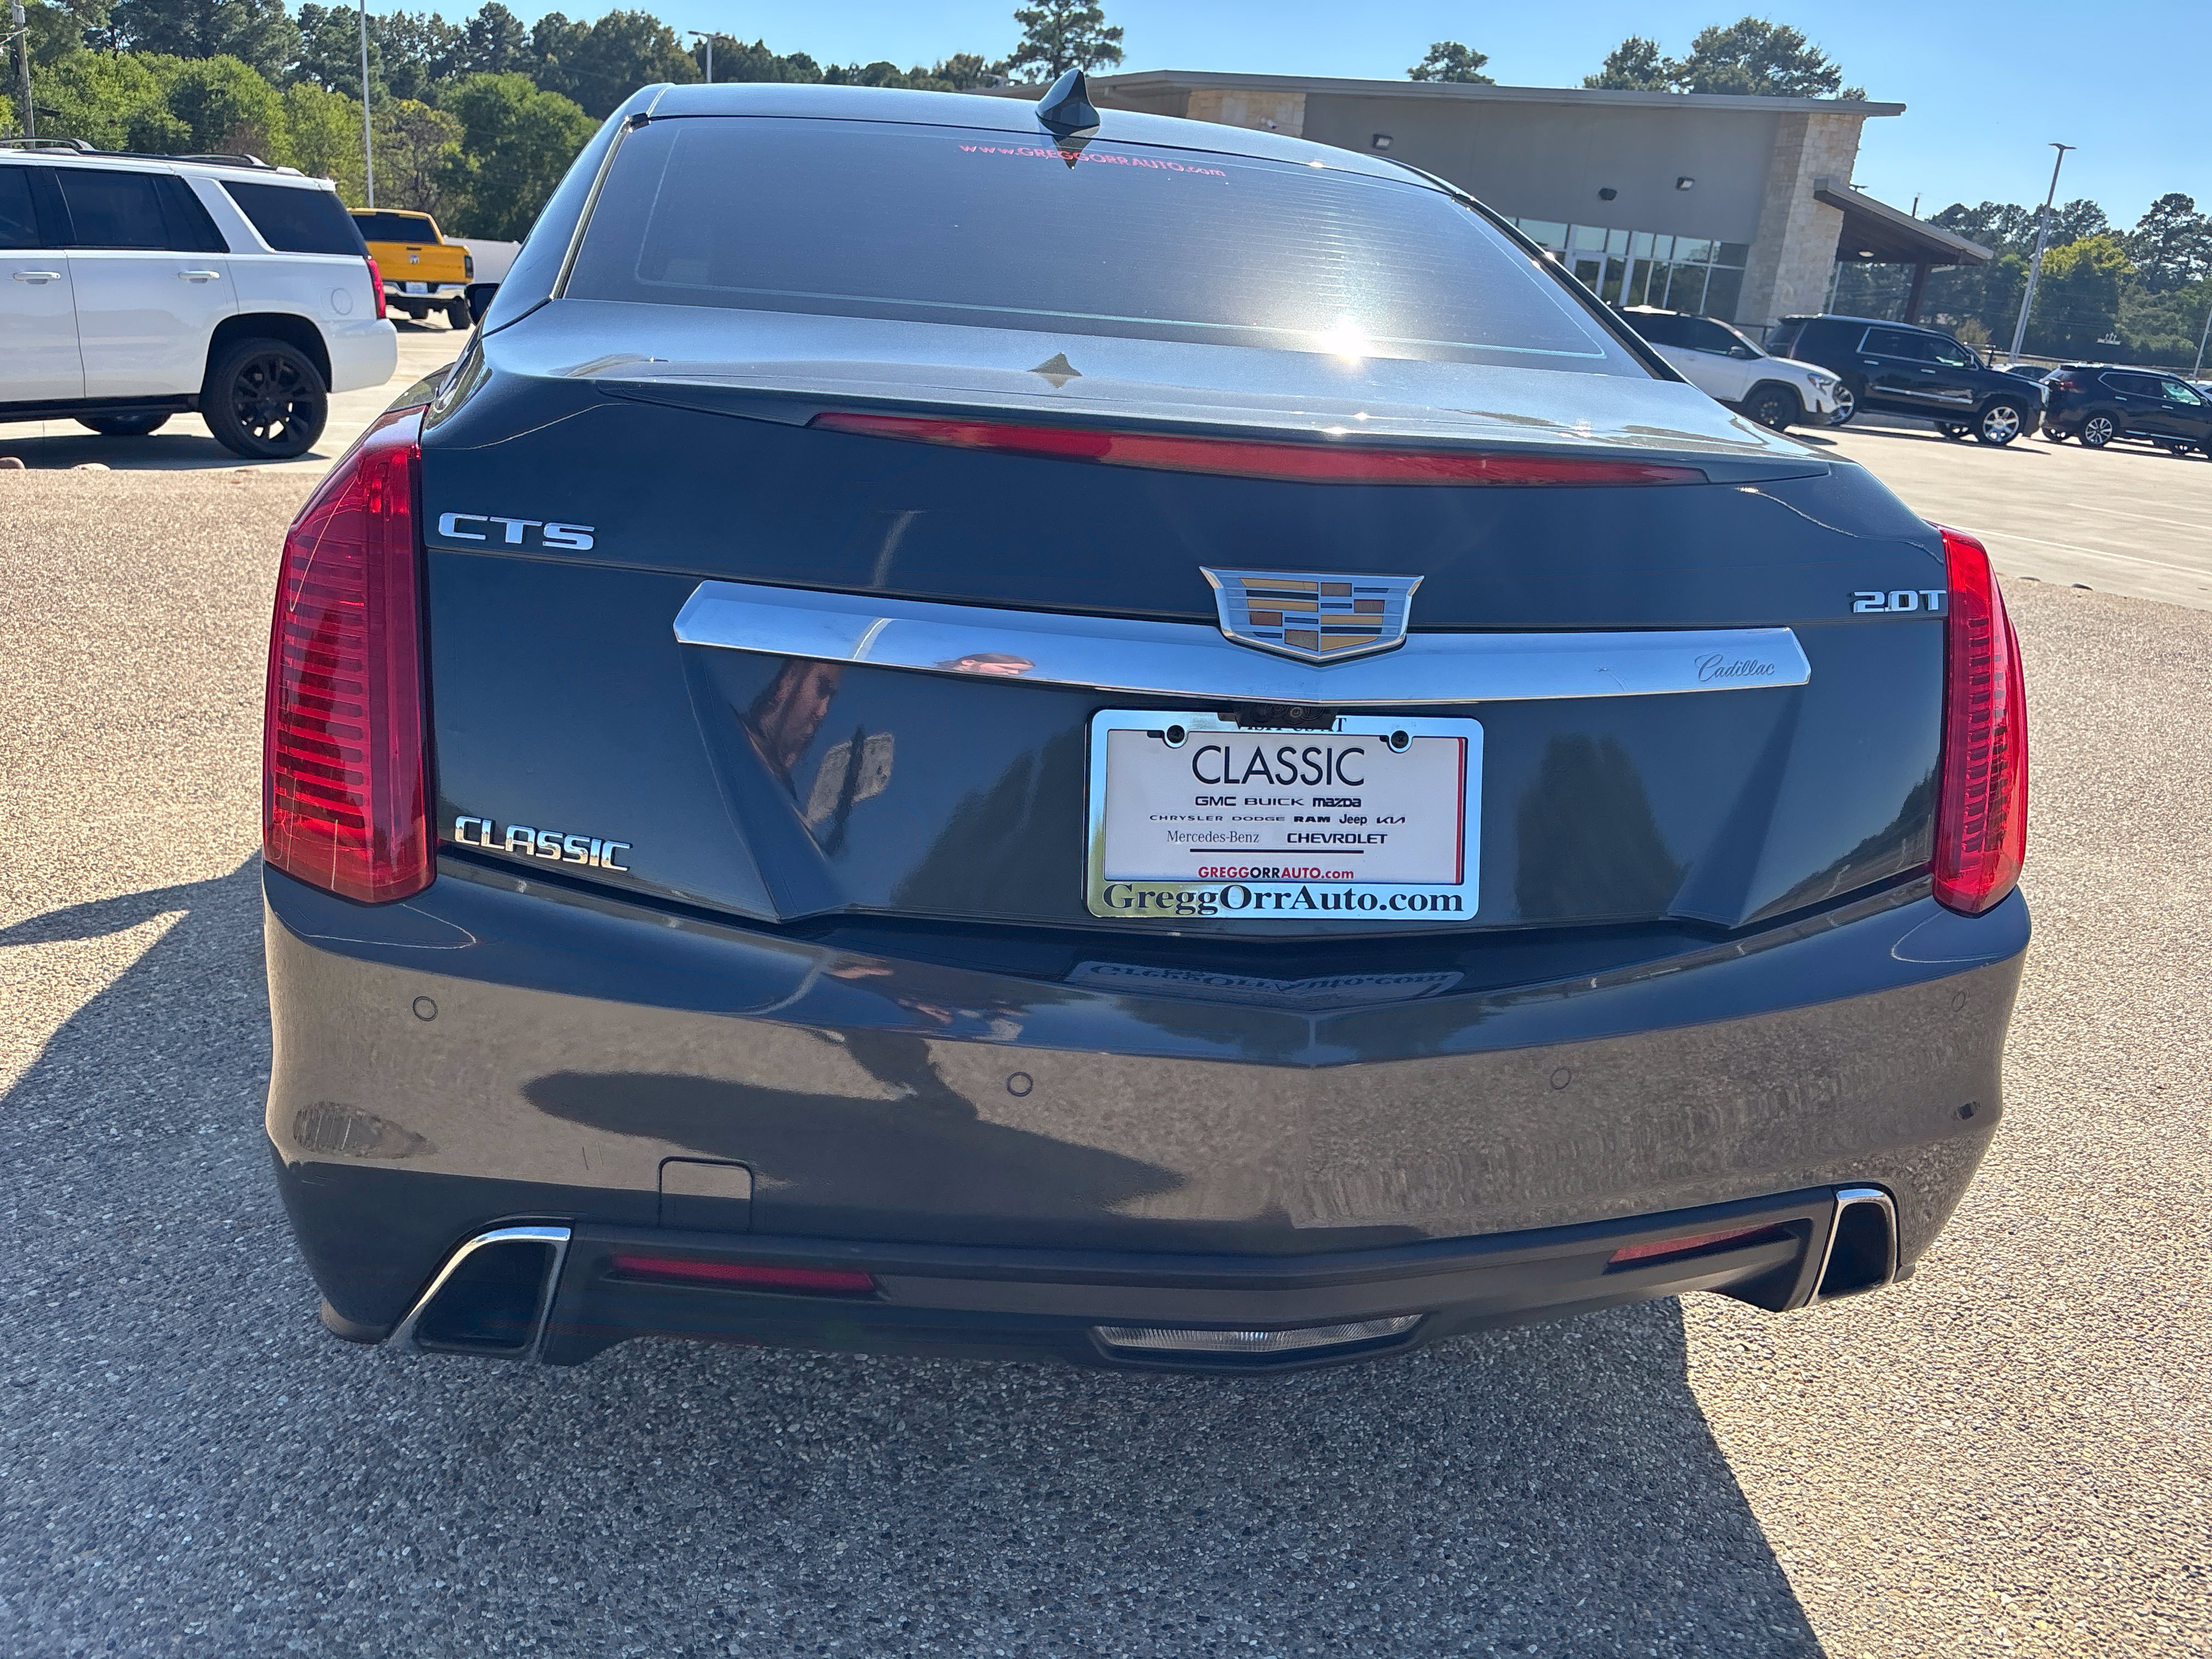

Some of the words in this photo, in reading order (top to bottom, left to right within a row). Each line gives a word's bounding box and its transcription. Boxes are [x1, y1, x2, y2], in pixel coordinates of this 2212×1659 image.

[959, 144, 1226, 177] www.GREGGORRAUTO.com
[438, 512, 595, 550] CTS
[1694, 652, 1775, 682] Cadillac
[1192, 745, 1365, 786] CLASSIC
[1195, 796, 1237, 806] GMC
[1244, 798, 1305, 806] BUICK
[1339, 814, 1367, 826] Jeep
[454, 816, 631, 871] CLASSIC
[1167, 830, 1260, 843] Mercedes-Benz
[1287, 833, 1388, 844] CHEVROLET
[1198, 866, 1355, 880] GREGGORRAUTO.com
[1103, 883, 1464, 916] GreggOrrAuto.com
